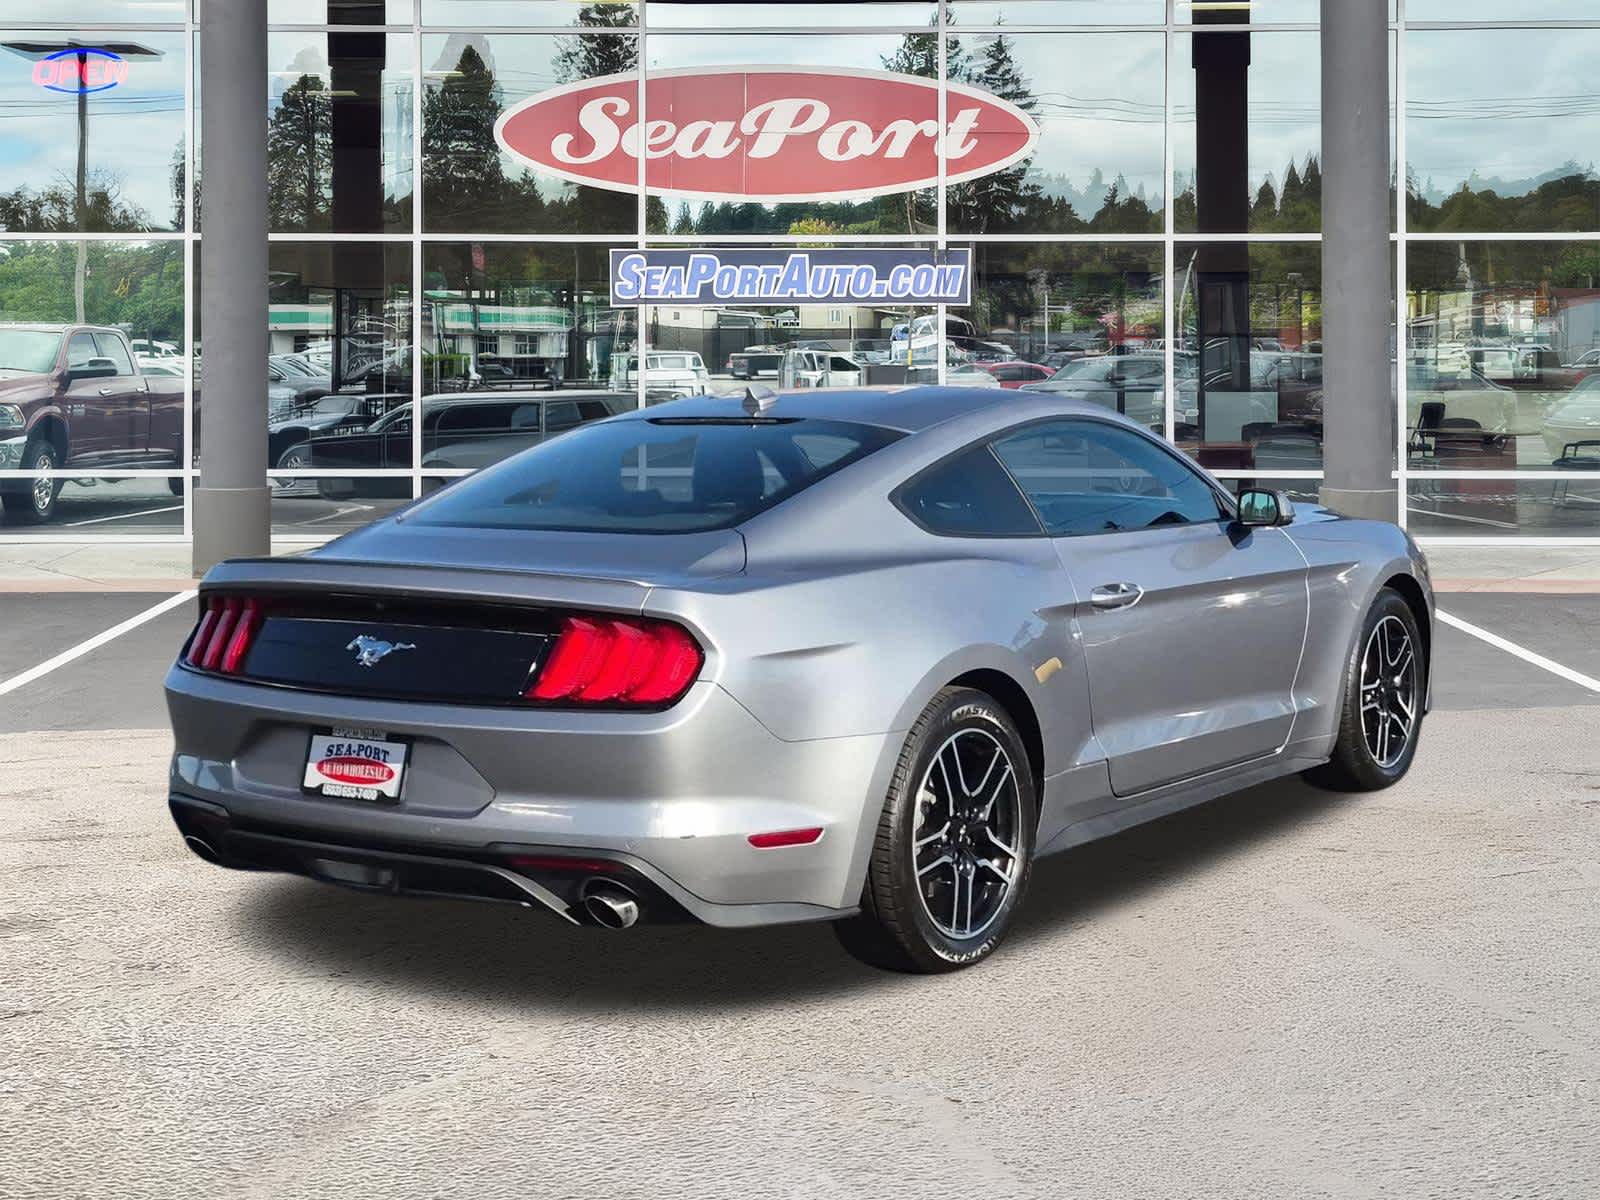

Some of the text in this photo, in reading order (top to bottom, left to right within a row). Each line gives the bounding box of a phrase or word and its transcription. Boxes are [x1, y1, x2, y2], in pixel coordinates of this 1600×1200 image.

[32, 59, 129, 86] OPEN
[550, 96, 982, 163] SeaPort
[325, 743, 390, 762] SEA-PORT
[321, 762, 390, 780] AUTO WHOLESALE
